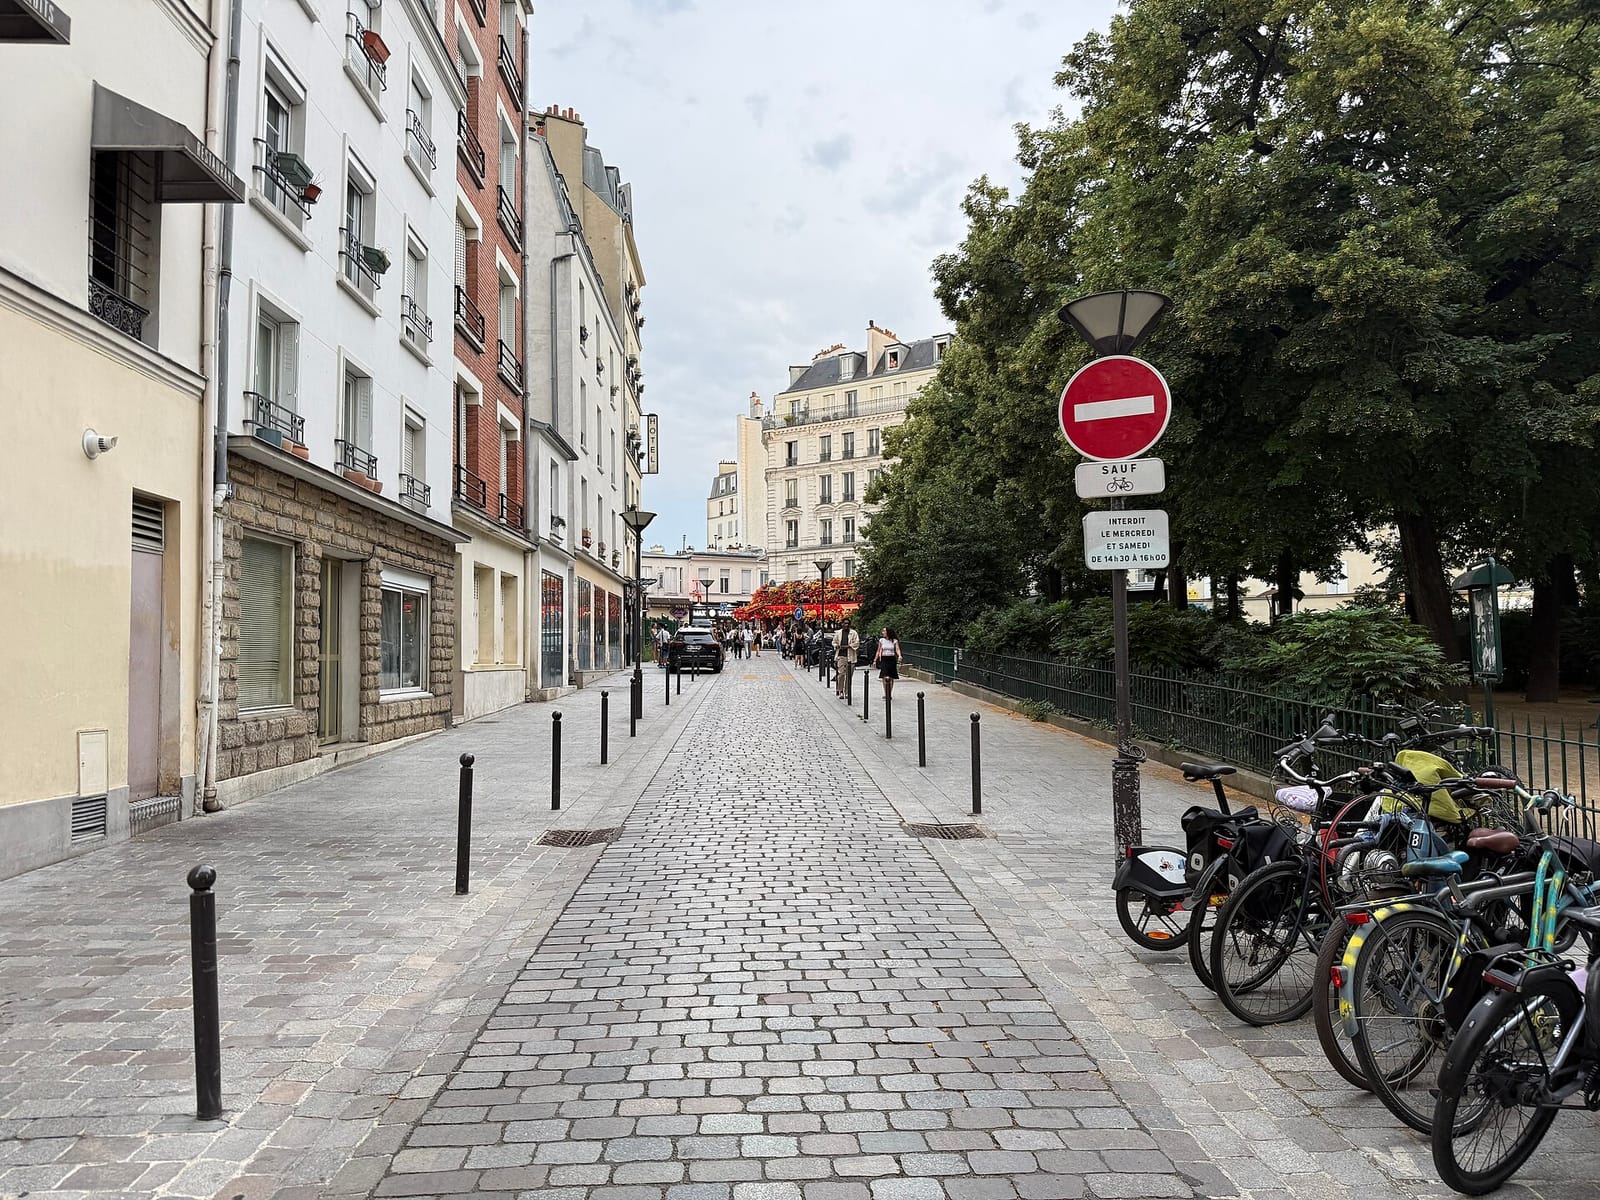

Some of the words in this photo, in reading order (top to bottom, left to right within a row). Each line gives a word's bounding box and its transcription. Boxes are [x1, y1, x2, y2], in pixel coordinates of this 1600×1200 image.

[1102, 464, 1137, 474] SAUF
[1109, 517, 1146, 525] INTERDIT
[1113, 529, 1155, 537] MERCREDI
[1118, 542, 1150, 550] SAMEDI
[1091, 555, 1102, 563] DE
[1104, 554, 1130, 562] 14h30
[1132, 553, 1138, 561] À
[1140, 554, 1166, 562] 16h00
[1411, 833, 1419, 846] B
